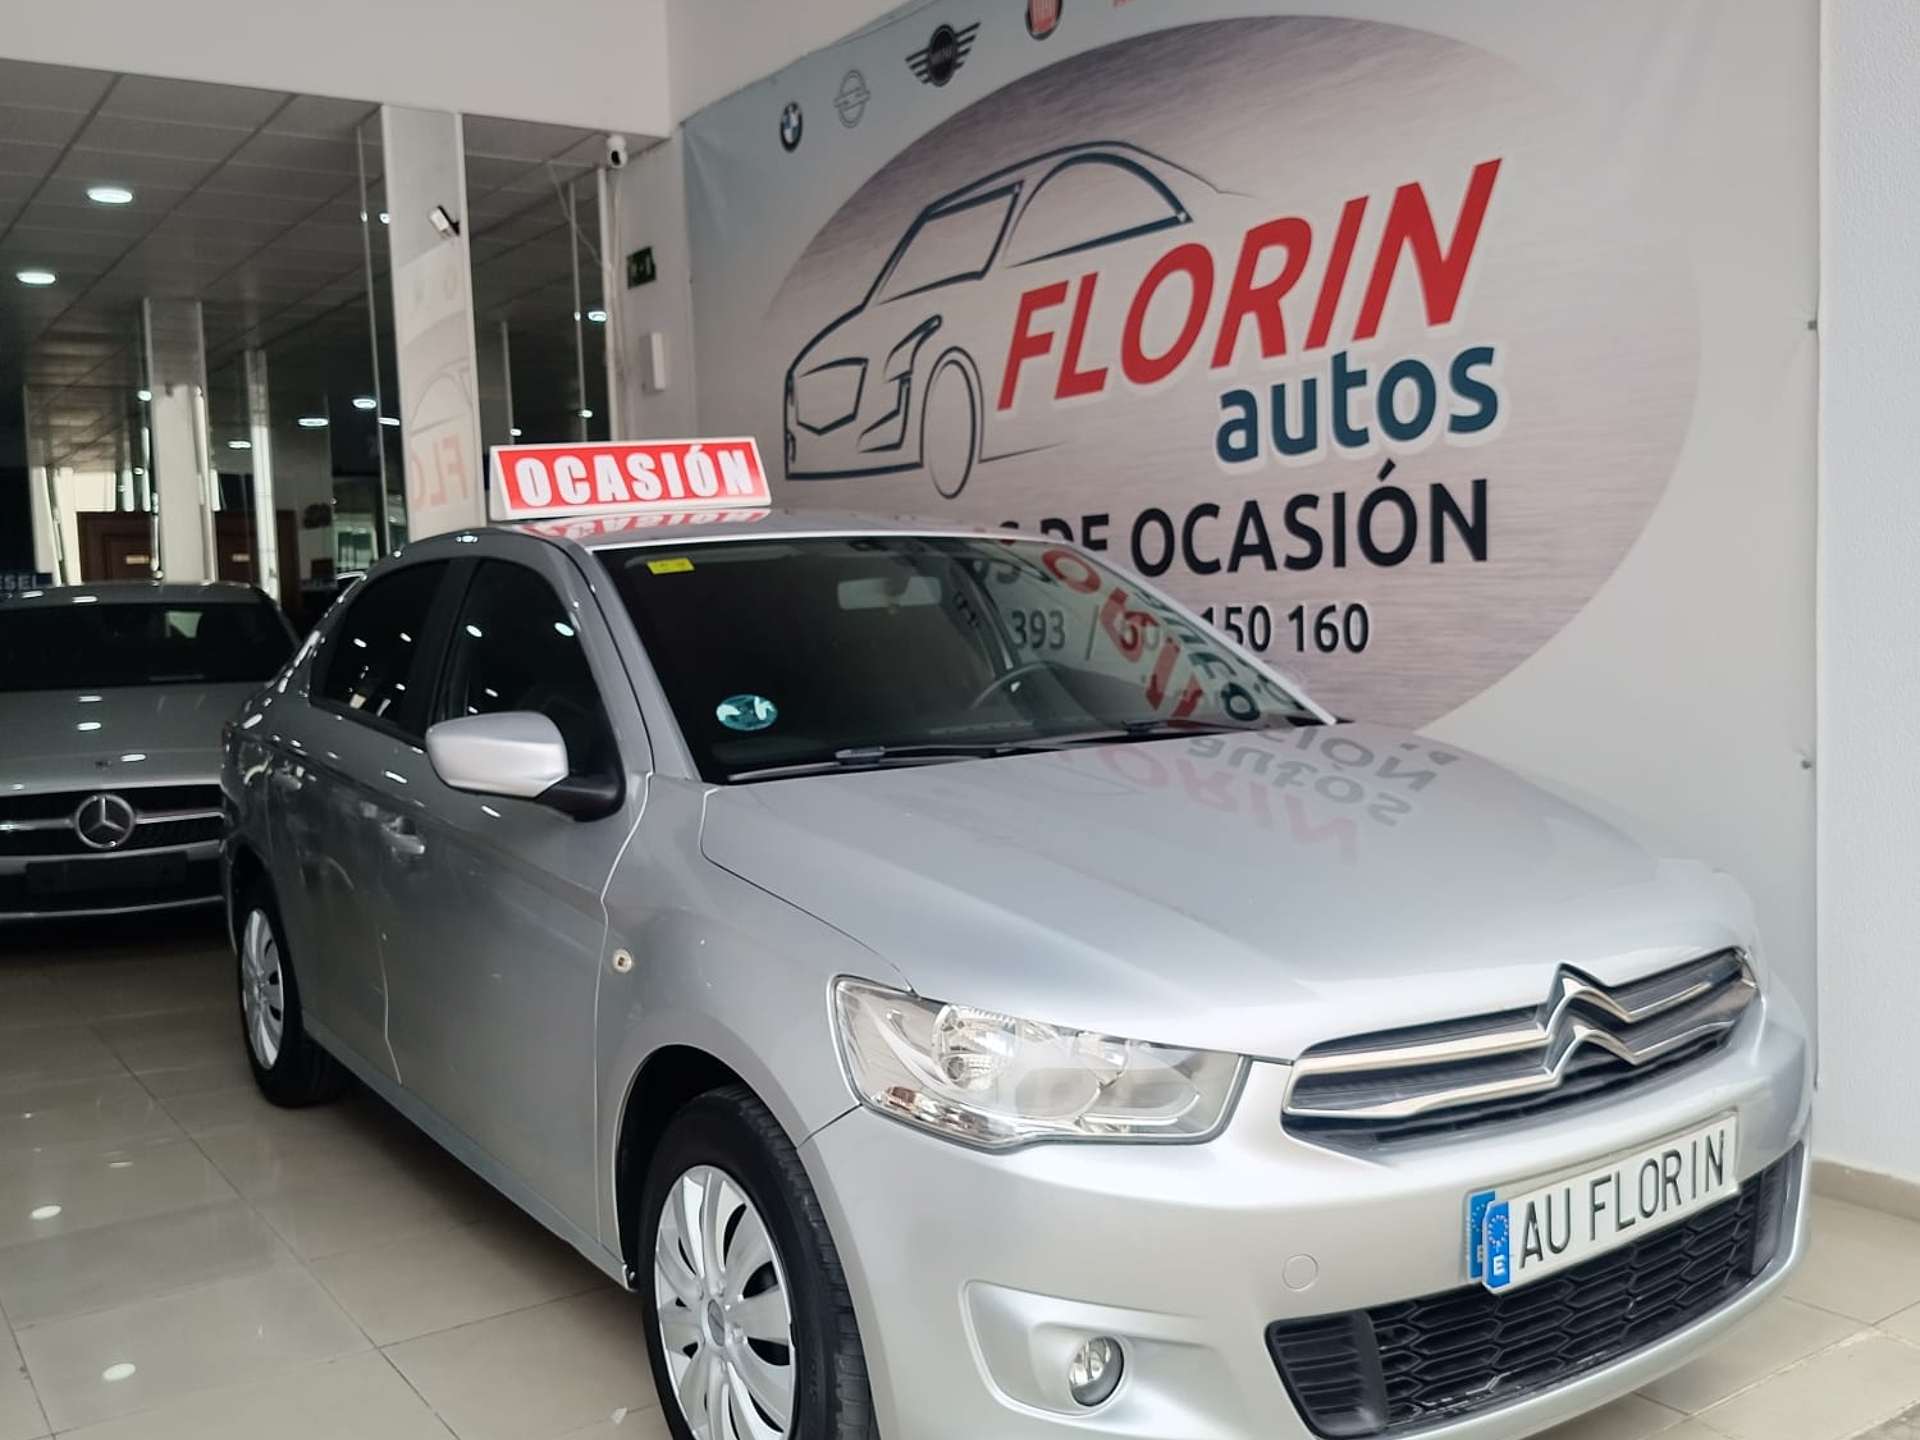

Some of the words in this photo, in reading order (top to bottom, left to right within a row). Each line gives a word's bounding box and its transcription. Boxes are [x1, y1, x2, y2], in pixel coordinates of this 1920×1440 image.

[997, 158, 1502, 412] FLORIN
[1216, 347, 1499, 464] autos
[514, 445, 754, 508] OCASIÓN
[1131, 459, 1488, 578] OCASIÓN
[1011, 608, 1066, 651] 393
[1288, 602, 1370, 653] 160
[1520, 1186, 1572, 1269] AU
[1589, 1129, 1725, 1241] FLORIN
[1493, 1254, 1507, 1276] E
